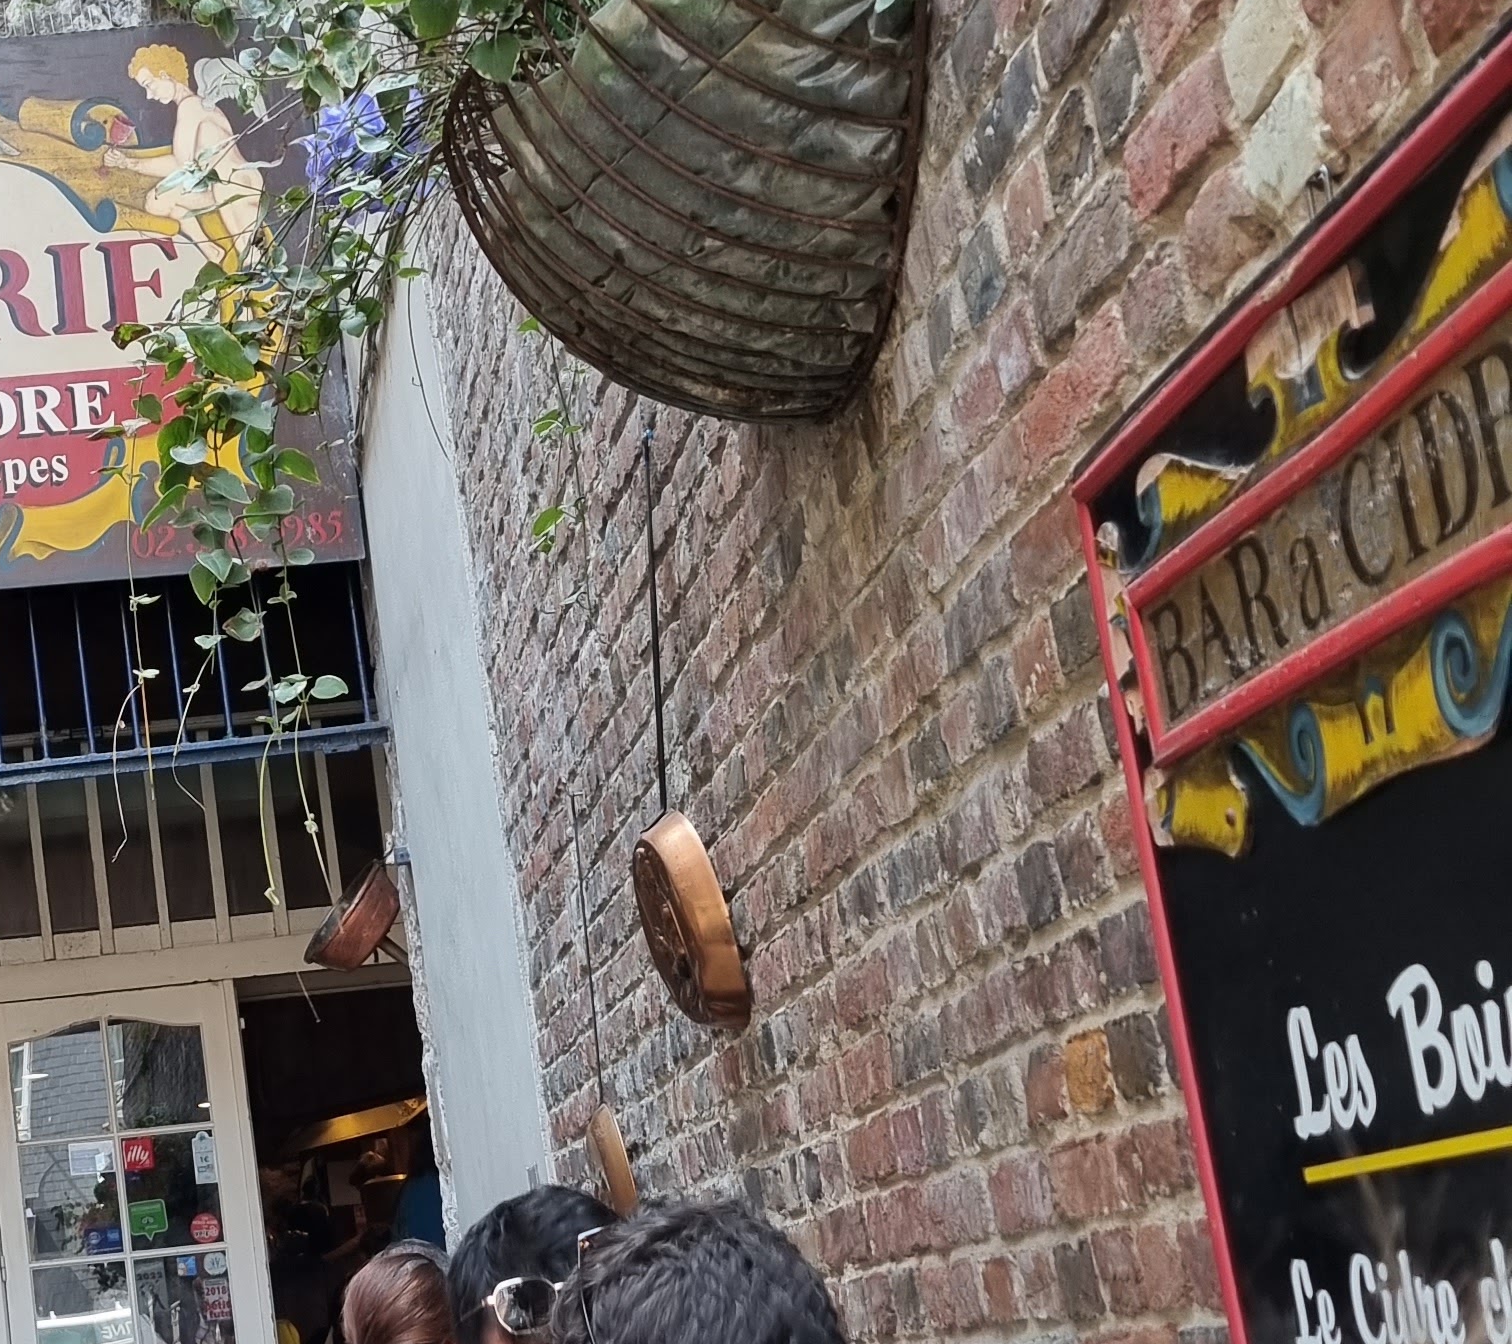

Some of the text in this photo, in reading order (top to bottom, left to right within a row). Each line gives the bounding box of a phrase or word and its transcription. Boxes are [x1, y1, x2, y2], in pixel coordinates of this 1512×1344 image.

[1149, 533, 1289, 722] BAR
[1287, 1005, 1377, 1140] Les
[127, 1145, 150, 1165] illy
[205, 1285, 227, 1296] 2018
